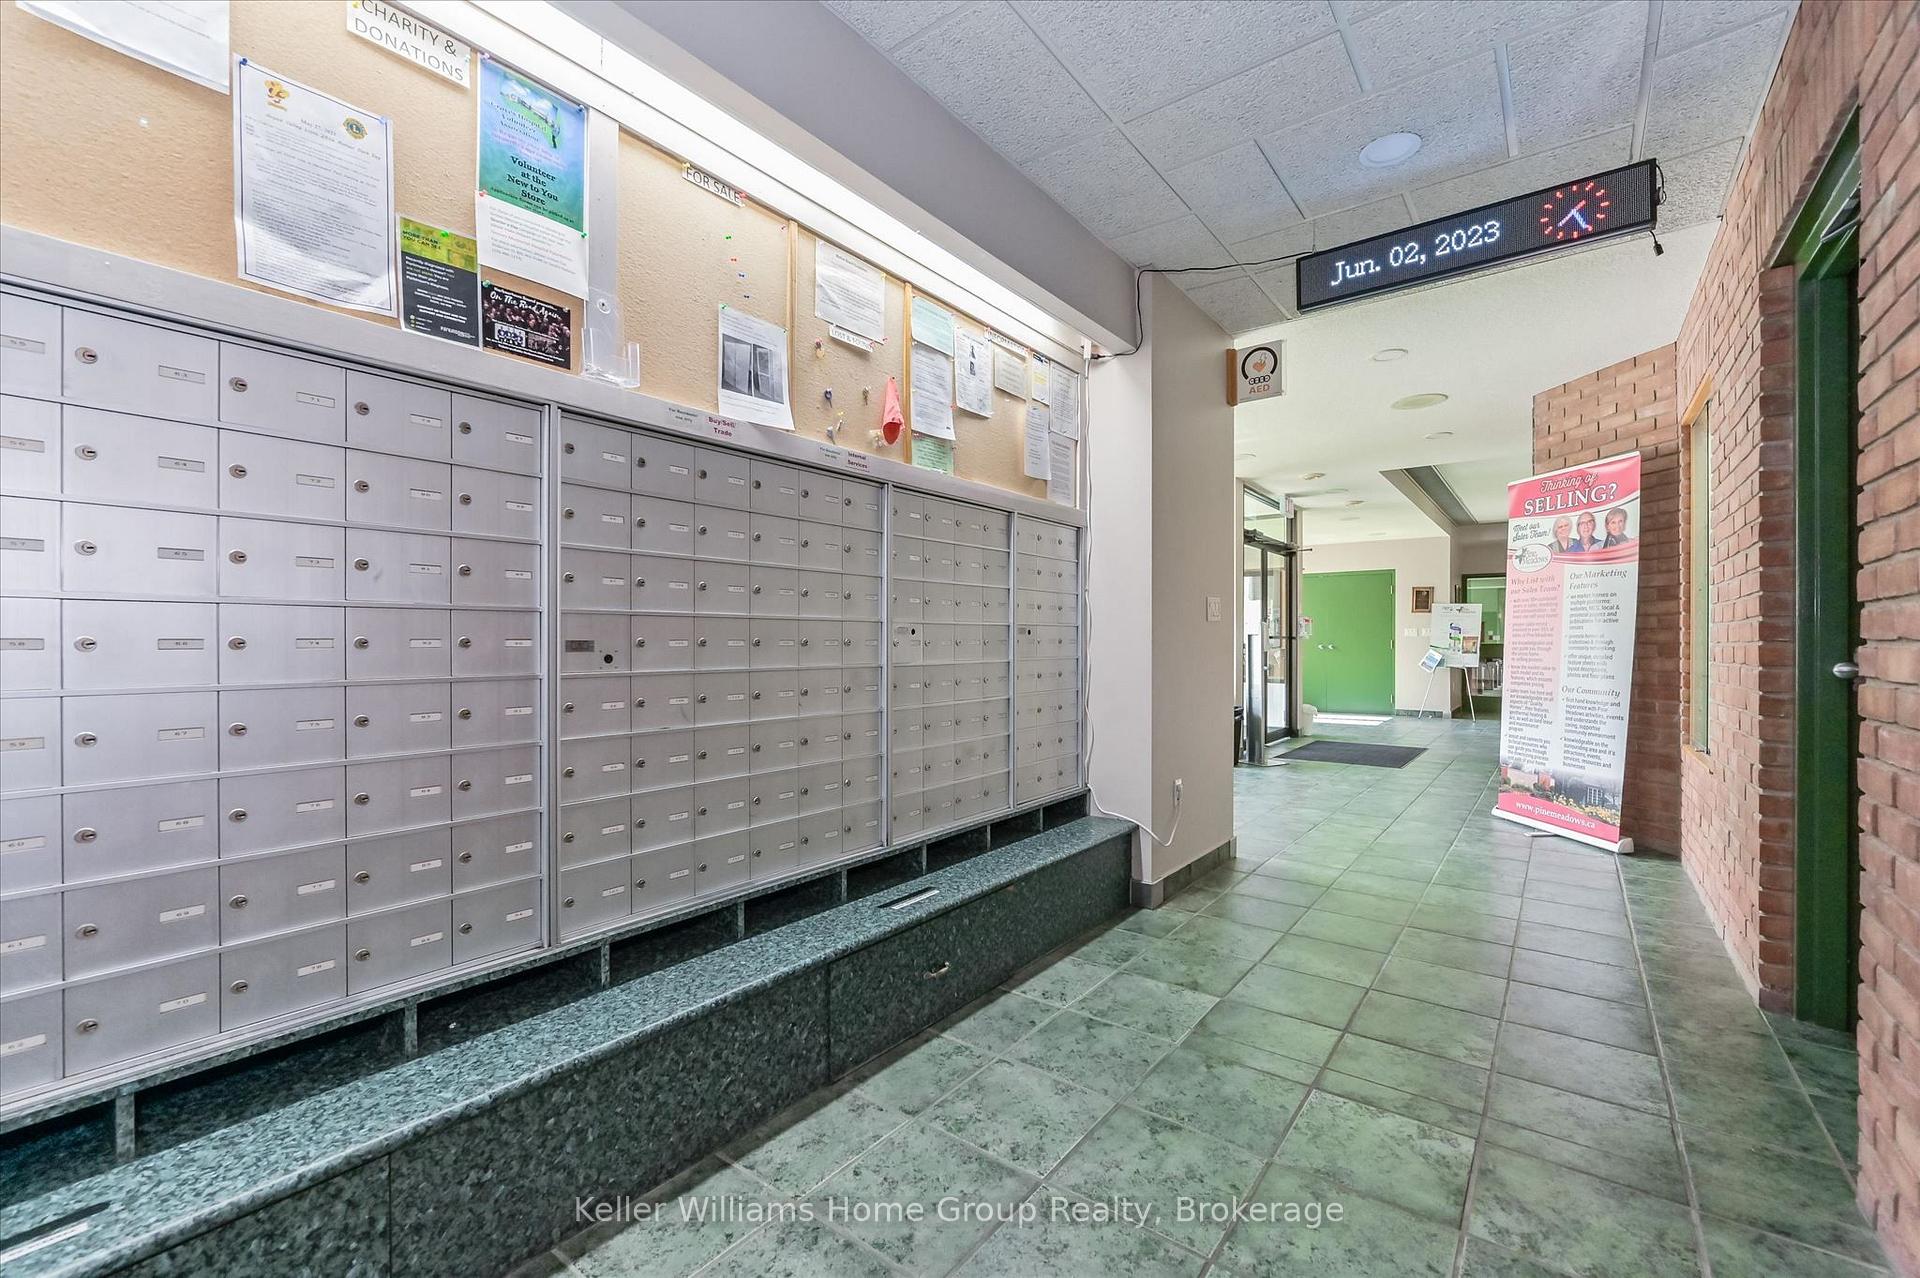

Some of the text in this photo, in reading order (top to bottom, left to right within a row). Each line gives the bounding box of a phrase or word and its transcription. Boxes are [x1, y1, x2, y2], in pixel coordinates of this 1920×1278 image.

[361, 0, 457, 57] CHARITY &
[354, 17, 464, 81] DONATIONS
[510, 156, 556, 182] Volunteer
[521, 170, 547, 187] at the
[686, 166, 743, 204] FOR SALE
[507, 174, 559, 202] New to You
[521, 189, 547, 206] Store
[421, 235, 438, 244] THAN
[1331, 220, 1501, 286] Jun. 02, 2023
[490, 290, 503, 301] On
[504, 295, 519, 306] The
[1249, 384, 1270, 395] AED
[714, 427, 733, 437] Trade
[848, 451, 866, 460] Internal
[848, 459, 868, 469] Services
[1540, 471, 1599, 493] Thinking of
[1523, 482, 1618, 516] SELLING?
[1511, 578, 1524, 587] Why
[1539, 575, 1555, 583] with
[1569, 568, 1628, 580] Our Marketing
[1522, 586, 1538, 594] Sales
[1540, 584, 1561, 593] Team?
[1569, 582, 1599, 591] Features
[1561, 684, 1621, 700] Our Community
[1610, 700, 1621, 708] and
[1515, 801, 1596, 829] www.pinemeadows.ca
